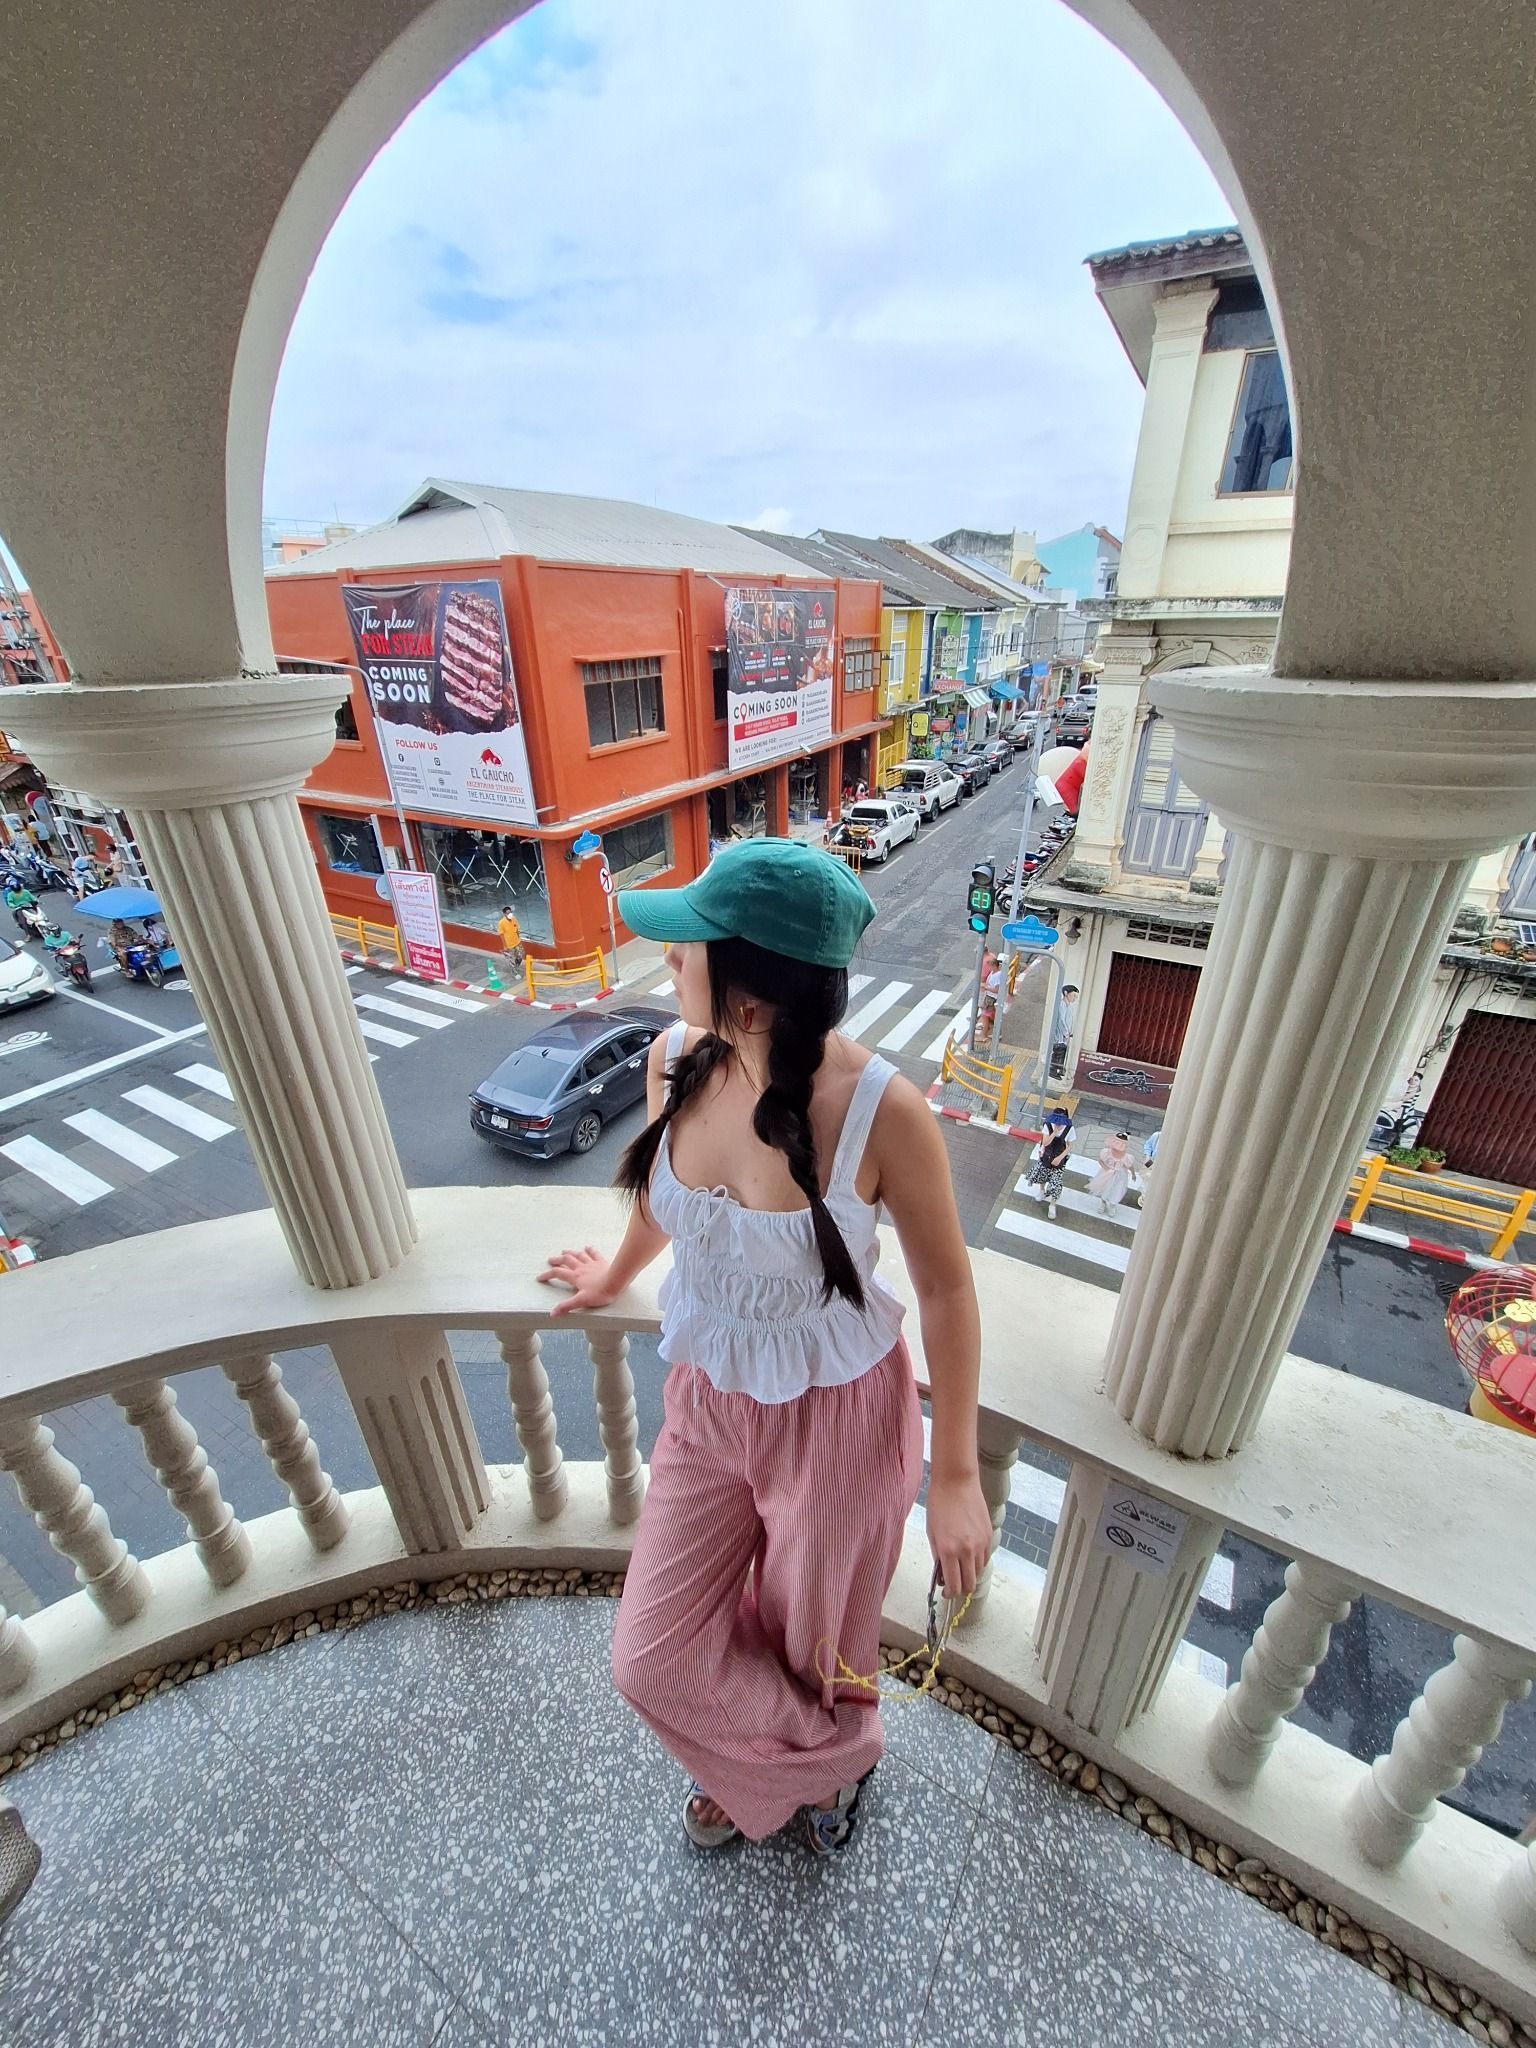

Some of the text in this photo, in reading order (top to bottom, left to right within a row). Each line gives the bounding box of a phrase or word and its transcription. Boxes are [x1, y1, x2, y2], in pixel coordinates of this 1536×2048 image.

[353, 606, 415, 639] The place
[361, 634, 434, 656] FOR STEAK
[368, 666, 427, 682] COMING
[373, 681, 431, 704] SOON
[733, 701, 771, 720] COMING
[775, 695, 798, 710] SOON
[395, 739, 438, 751] FOLLOW US
[742, 744, 750, 752] ARE
[470, 767, 514, 783] EL GAUCHO
[480, 792, 495, 800] PLACE
[497, 794, 508, 802] FOR
[509, 796, 526, 805] STEAK
[971, 890, 990, 909] 23
[1137, 1540, 1157, 1555] NO
